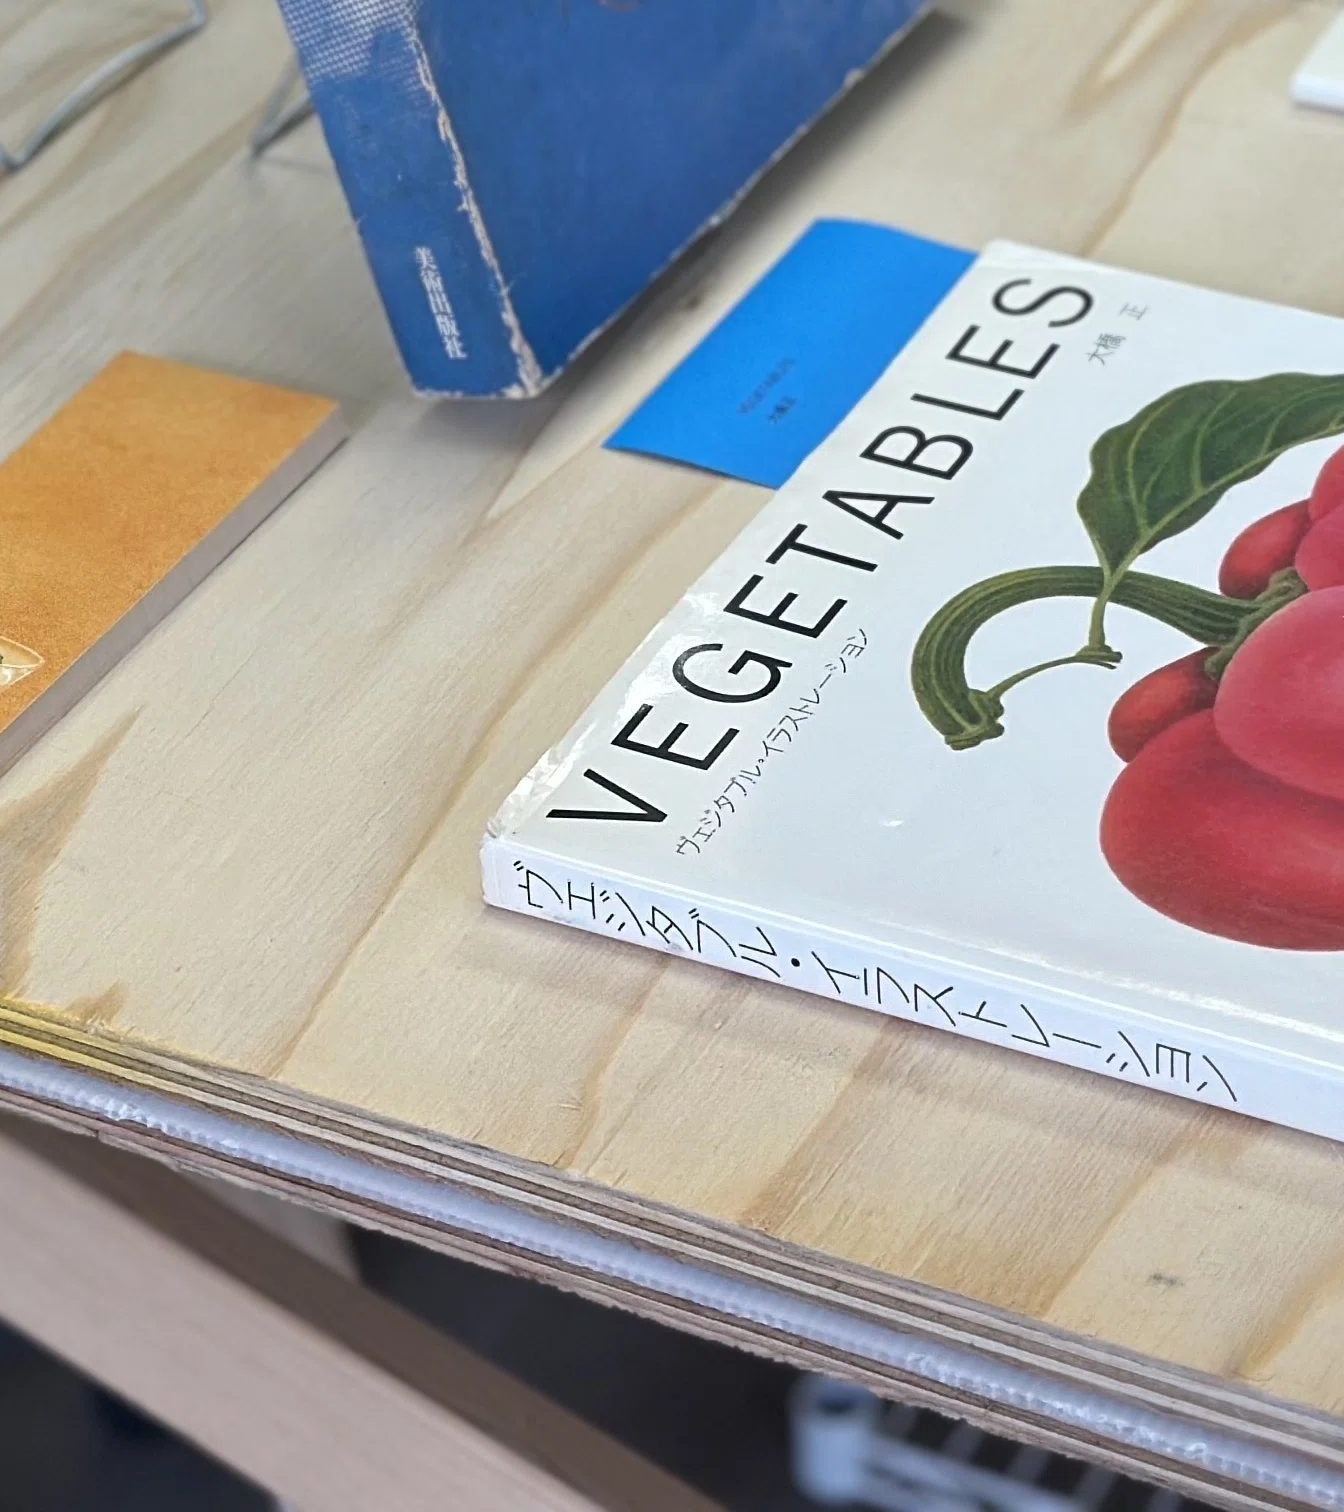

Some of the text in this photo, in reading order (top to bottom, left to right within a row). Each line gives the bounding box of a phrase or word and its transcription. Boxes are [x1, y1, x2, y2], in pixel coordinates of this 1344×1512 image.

[415, 246, 468, 359] 美術出版社
[1085, 333, 1127, 367] 大橋
[545, 278, 1094, 823] VEGETABLES
[676, 628, 868, 855] ヴェジタブル・イラストレーション
[513, 859, 1239, 1103] ヴェジタブル・イラストレーション
